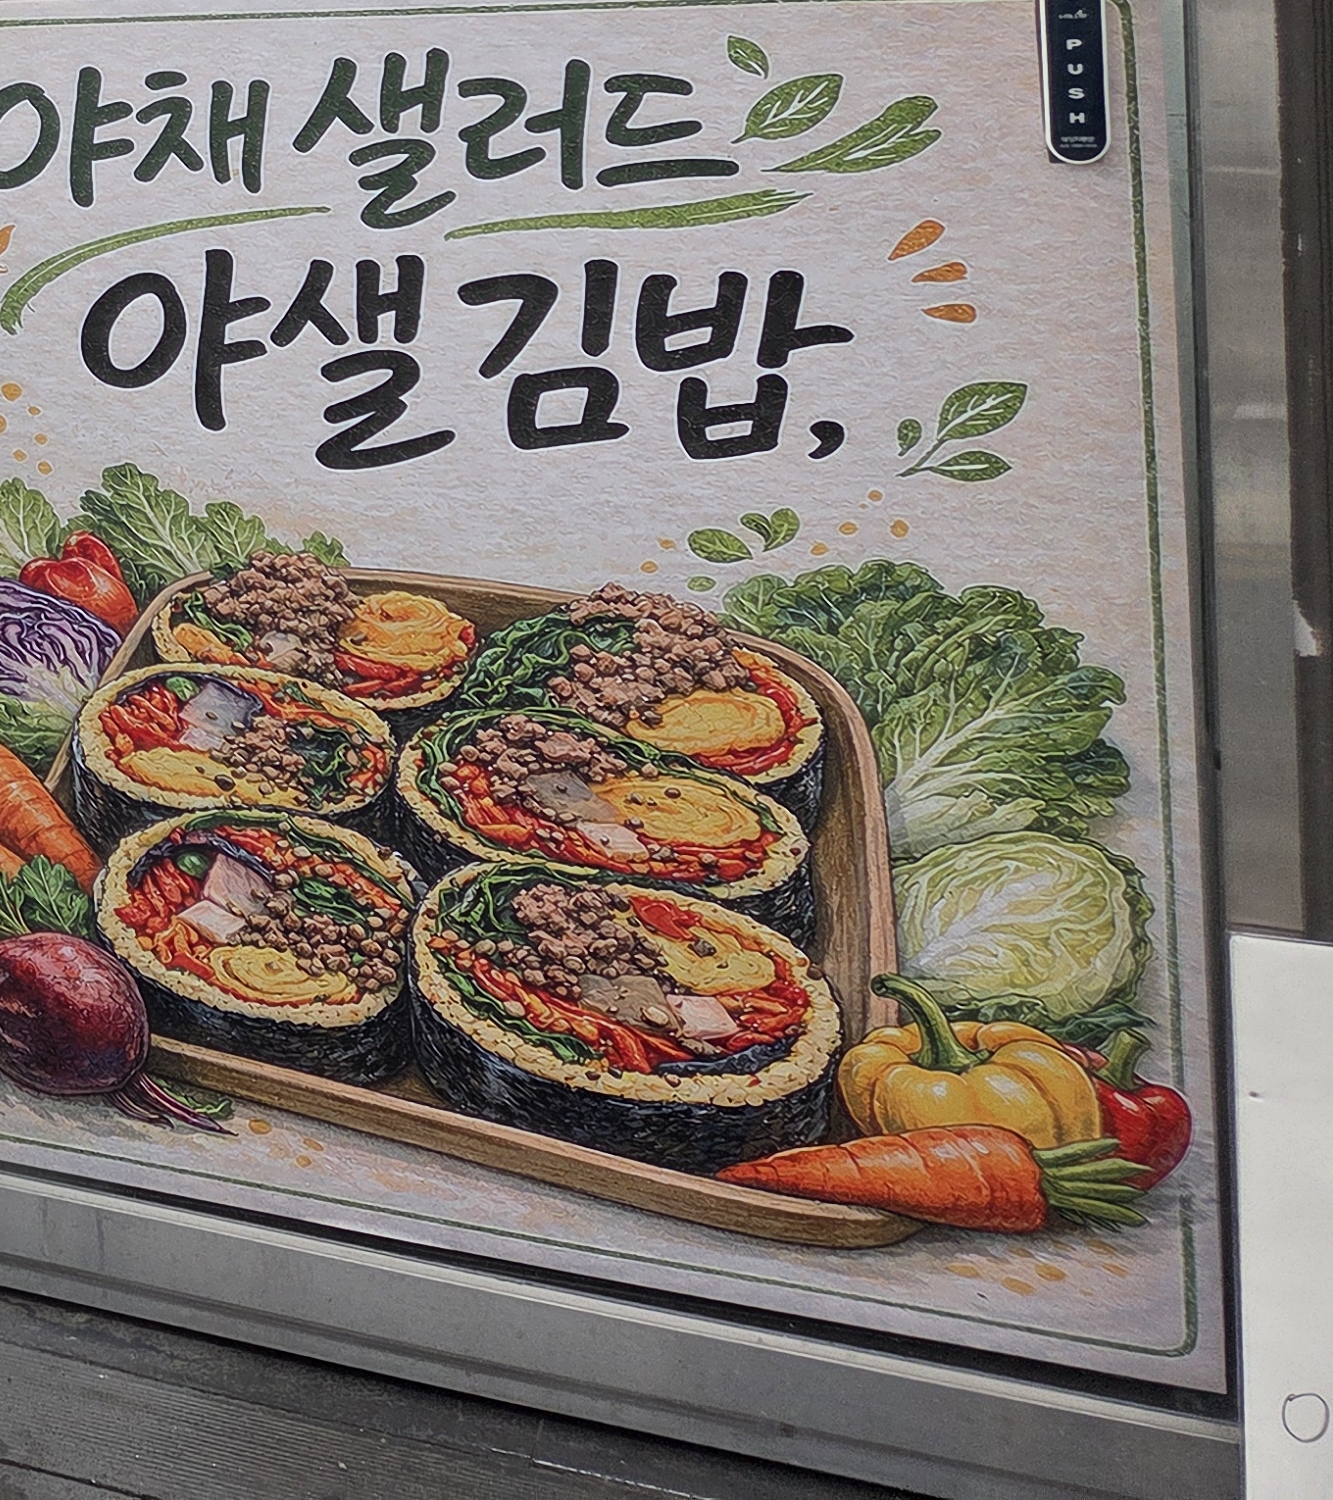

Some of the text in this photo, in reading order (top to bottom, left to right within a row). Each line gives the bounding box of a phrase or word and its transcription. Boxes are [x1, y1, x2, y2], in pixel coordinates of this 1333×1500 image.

[291, 46, 740, 230] 샐러드
[1065, 38, 1086, 124] PUSH
[79, 247, 456, 472] 야샐
